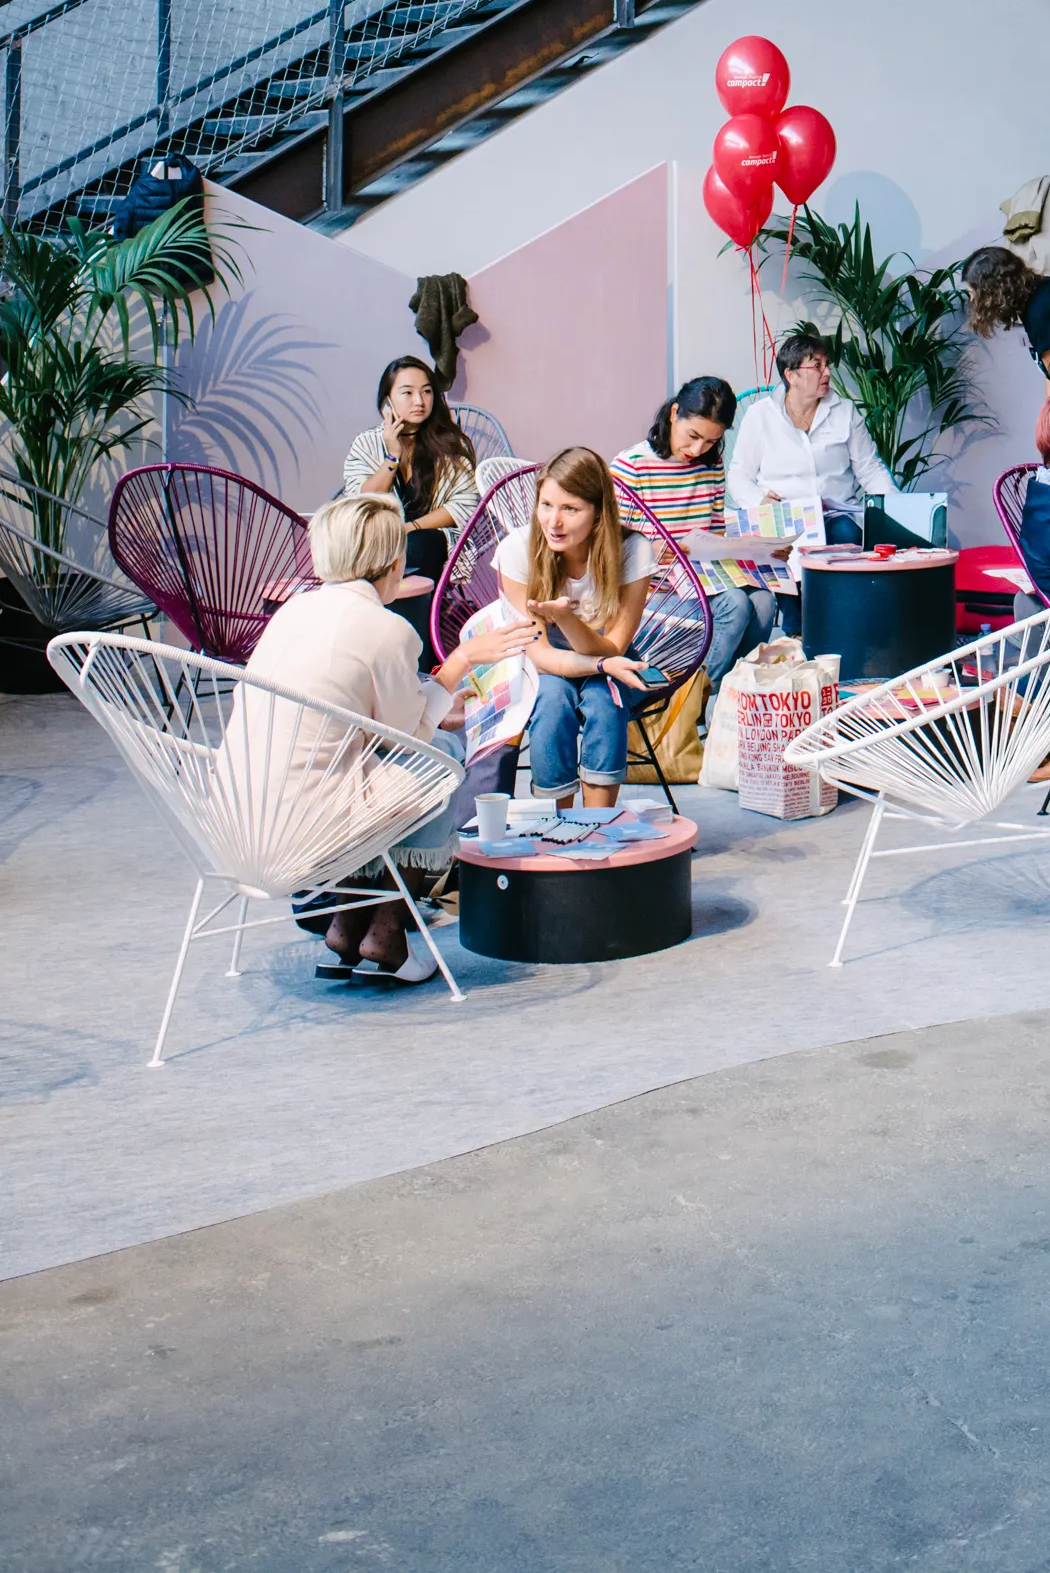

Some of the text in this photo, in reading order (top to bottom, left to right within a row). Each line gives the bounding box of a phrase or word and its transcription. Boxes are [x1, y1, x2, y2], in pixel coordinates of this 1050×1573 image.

[738, 691, 758, 712] OM
[757, 690, 811, 712] TOKYO
[775, 711, 811, 728] TOKYO
[745, 728, 778, 741] LONDON
[781, 728, 805, 743] PAR
[772, 742, 787, 753] SHA
